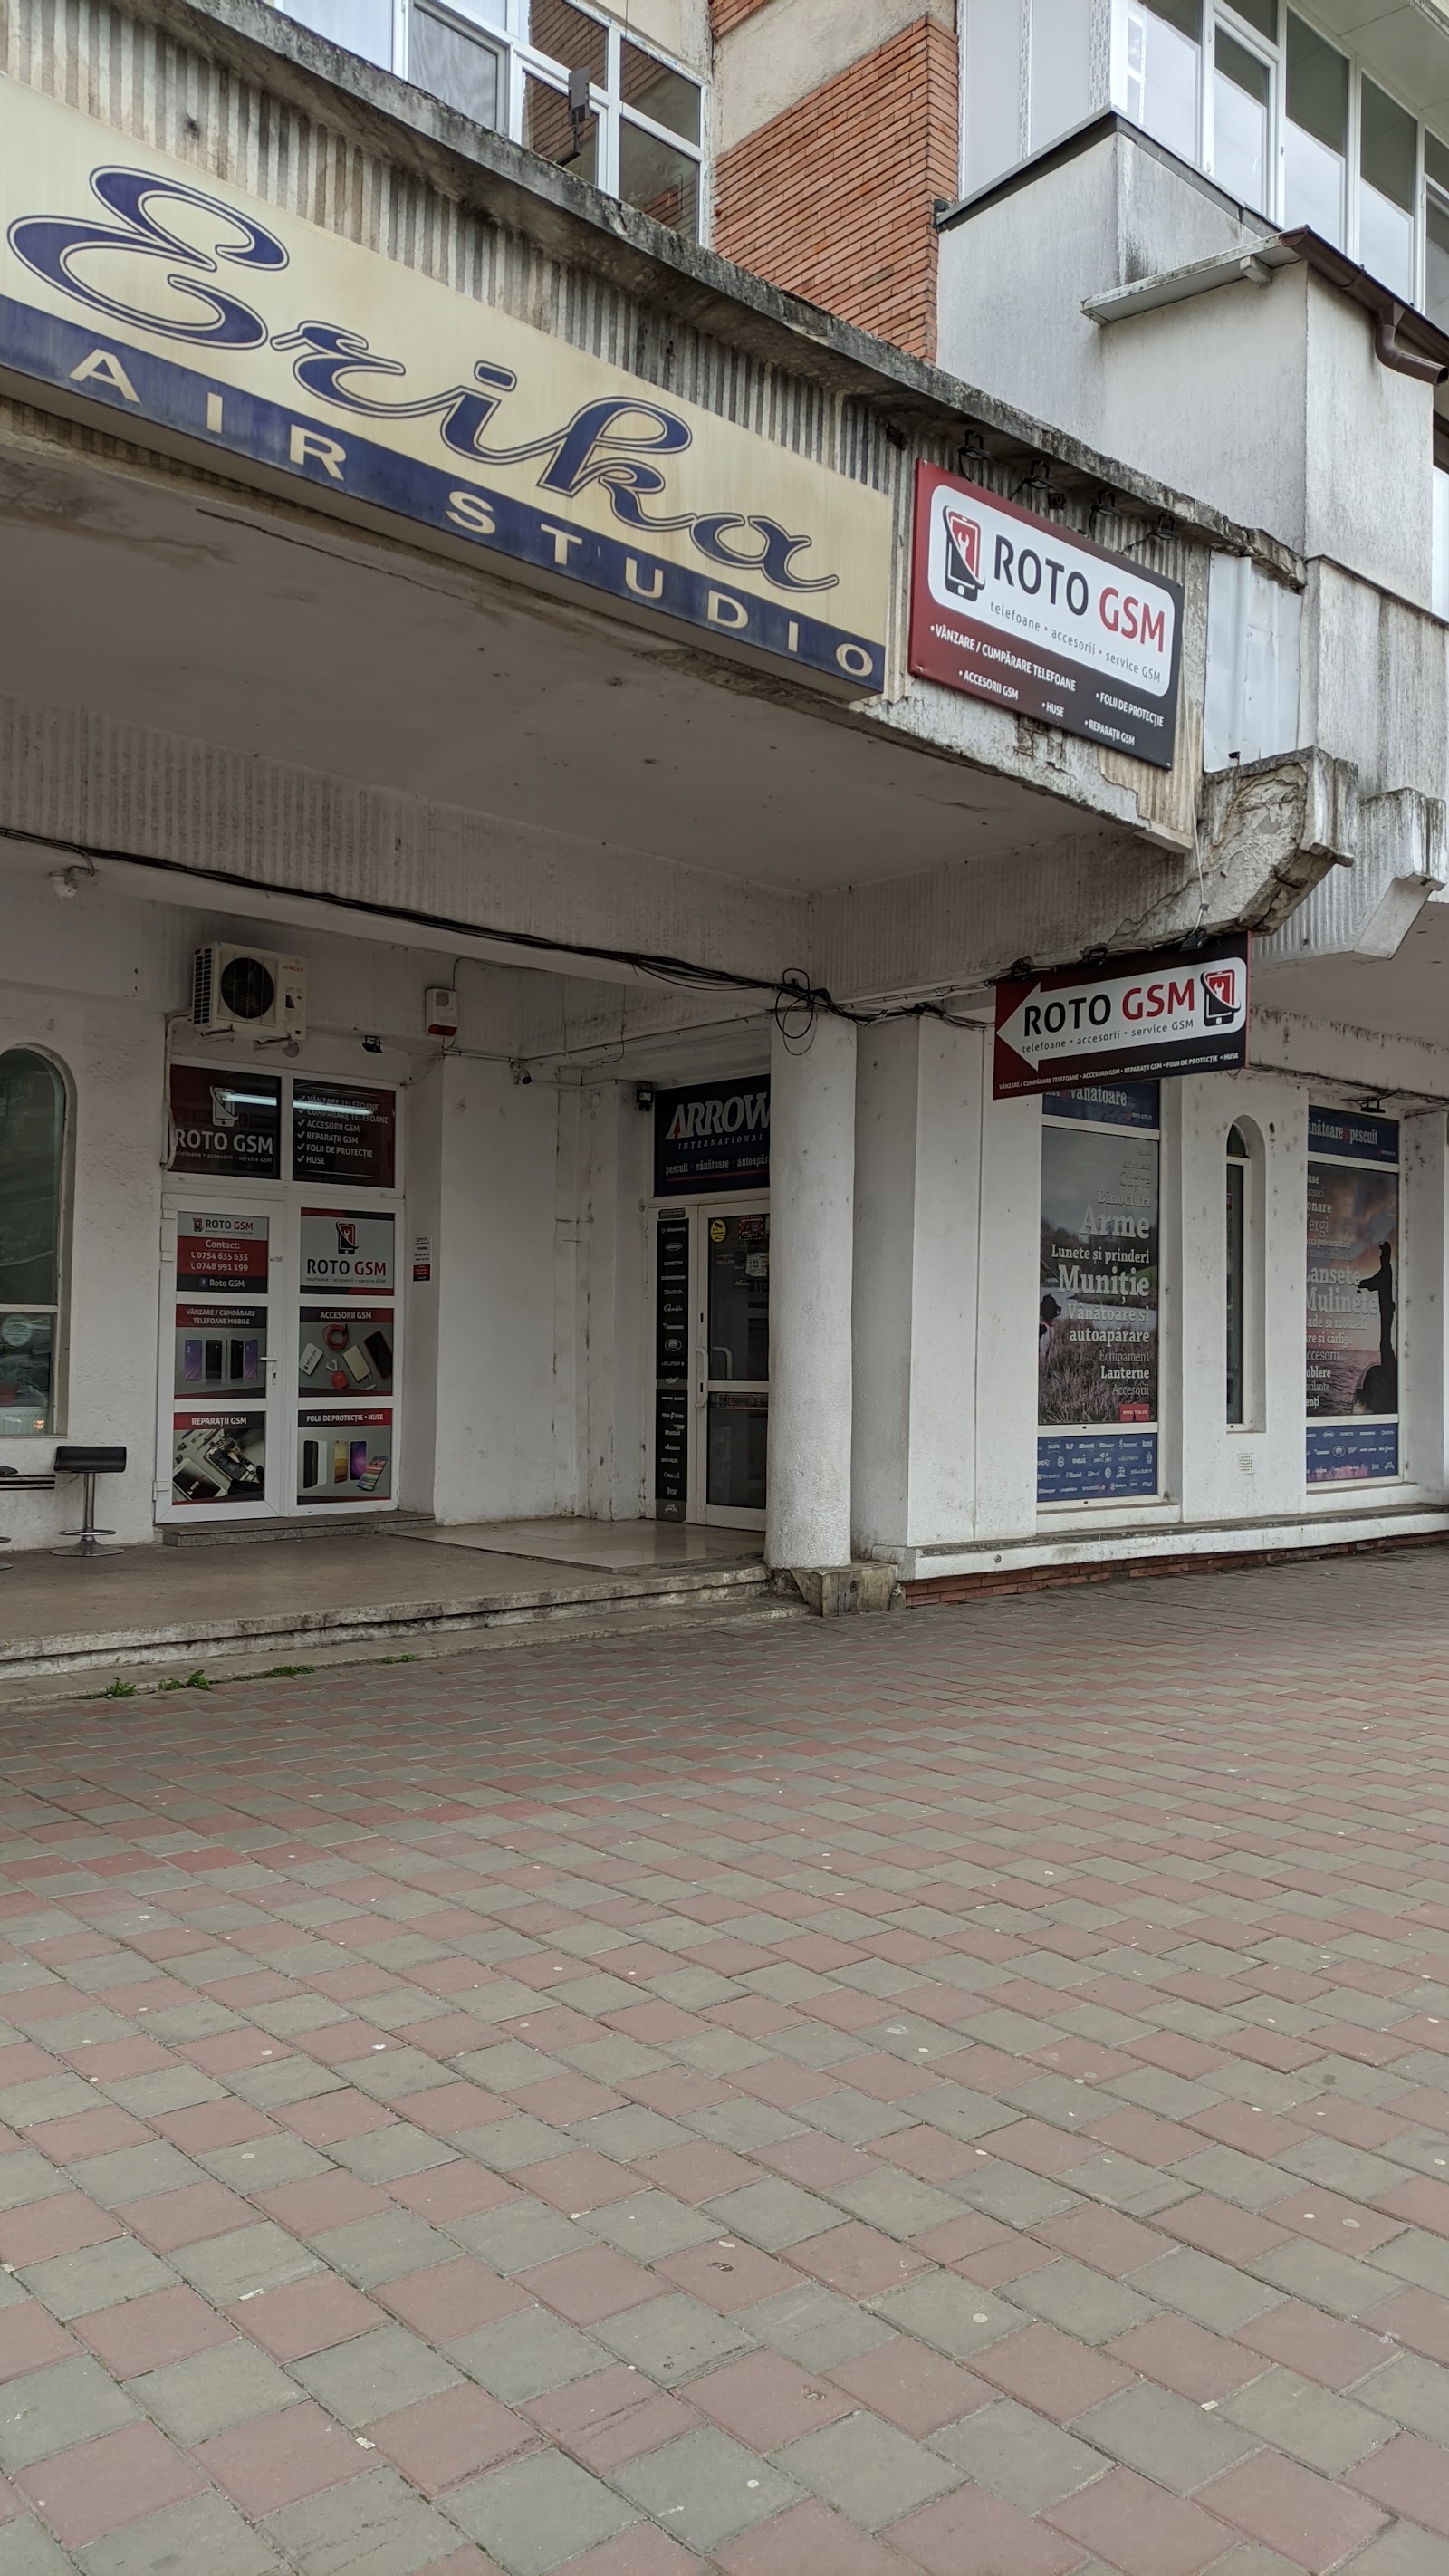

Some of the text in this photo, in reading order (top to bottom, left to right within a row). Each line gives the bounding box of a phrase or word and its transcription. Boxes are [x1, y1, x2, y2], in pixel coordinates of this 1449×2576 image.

[7, 165, 839, 591] Erika
[69, 349, 874, 678] AIR STUDIO
[993, 533, 1165, 653] ROTO GSM
[990, 601, 1161, 683] telefoane accesorii service GSM
[936, 623, 974, 652] VÂNZARE
[982, 643, 1032, 674] CUMPĂRARE
[1033, 666, 1076, 692] TELEFOANE
[964, 670, 1019, 701] ACCESORII GSM
[1046, 702, 1064, 717] HUSE
[1099, 692, 1118, 710] FOLII
[1118, 699, 1128, 714] DE
[1120, 731, 1136, 746] GSM
[1023, 978, 1195, 1037] ROTO GSM
[1022, 1019, 1194, 1053] telefoane accesorii service GSM
[999, 1081, 1020, 1090] VÂNZARE
[1023, 1076, 1051, 1087] CUMPĂRARE
[1052, 1073, 1079, 1083] TELEFOANE
[1082, 1070, 1108, 1080] ACCESORII
[1108, 1067, 1120, 1076] GSM
[1150, 1062, 1162, 1071] GSM
[1166, 1059, 1179, 1069] FOLII
[1180, 1058, 1188, 1066] DE
[1223, 1052, 1239, 1061] HUSE
[665, 1091, 770, 1140] ARROW
[307, 1120, 360, 1132] ACCESORII GSM
[1308, 1117, 1377, 1145] ânătoare pescuit
[175, 1128, 273, 1155] ROTO GSM
[306, 1144, 324, 1153] FOLII
[343, 1136, 359, 1144] GSM
[678, 1134, 763, 1150] INTERNATIONAL
[306, 1156, 326, 1165] HUSE
[666, 1162, 688, 1176] pescuit
[696, 1157, 729, 1172] vânătoare
[1097, 1189, 1151, 1208] Binocluri
[206, 1219, 254, 1231] ROTO GSM
[1080, 1204, 1150, 1239] Arme
[1307, 1215, 1329, 1238] ergi
[206, 1239, 241, 1249] Contact:
[196, 1251, 248, 1262] 0754 635 635
[1051, 1243, 1150, 1265] Lunete și prinderi
[196, 1262, 248, 1272] 0748 991 199
[307, 1259, 386, 1276] ROTO GSM
[209, 1278, 245, 1287] Roto GSM
[1058, 1264, 1150, 1304] Muniție
[186, 1307, 215, 1316] VÂNZARE
[219, 1308, 255, 1317] CUMPĂRARE
[320, 1311, 372, 1320] ACCESORII GSM
[1067, 1302, 1136, 1322] Vânătoare
[1069, 1327, 1150, 1348] autoapărare
[1327, 1331, 1353, 1348] cârlige
[1099, 1349, 1150, 1365] Echipament
[1307, 1348, 1339, 1361] ccesorii
[1100, 1365, 1150, 1379] Lanterne
[1307, 1365, 1331, 1378] oblere
[1112, 1381, 1150, 1397] Accesorii
[230, 1417, 247, 1426] GSM
[306, 1414, 322, 1423] FOLII
[322, 1414, 331, 1422] DE
[368, 1413, 384, 1421] HUSE
